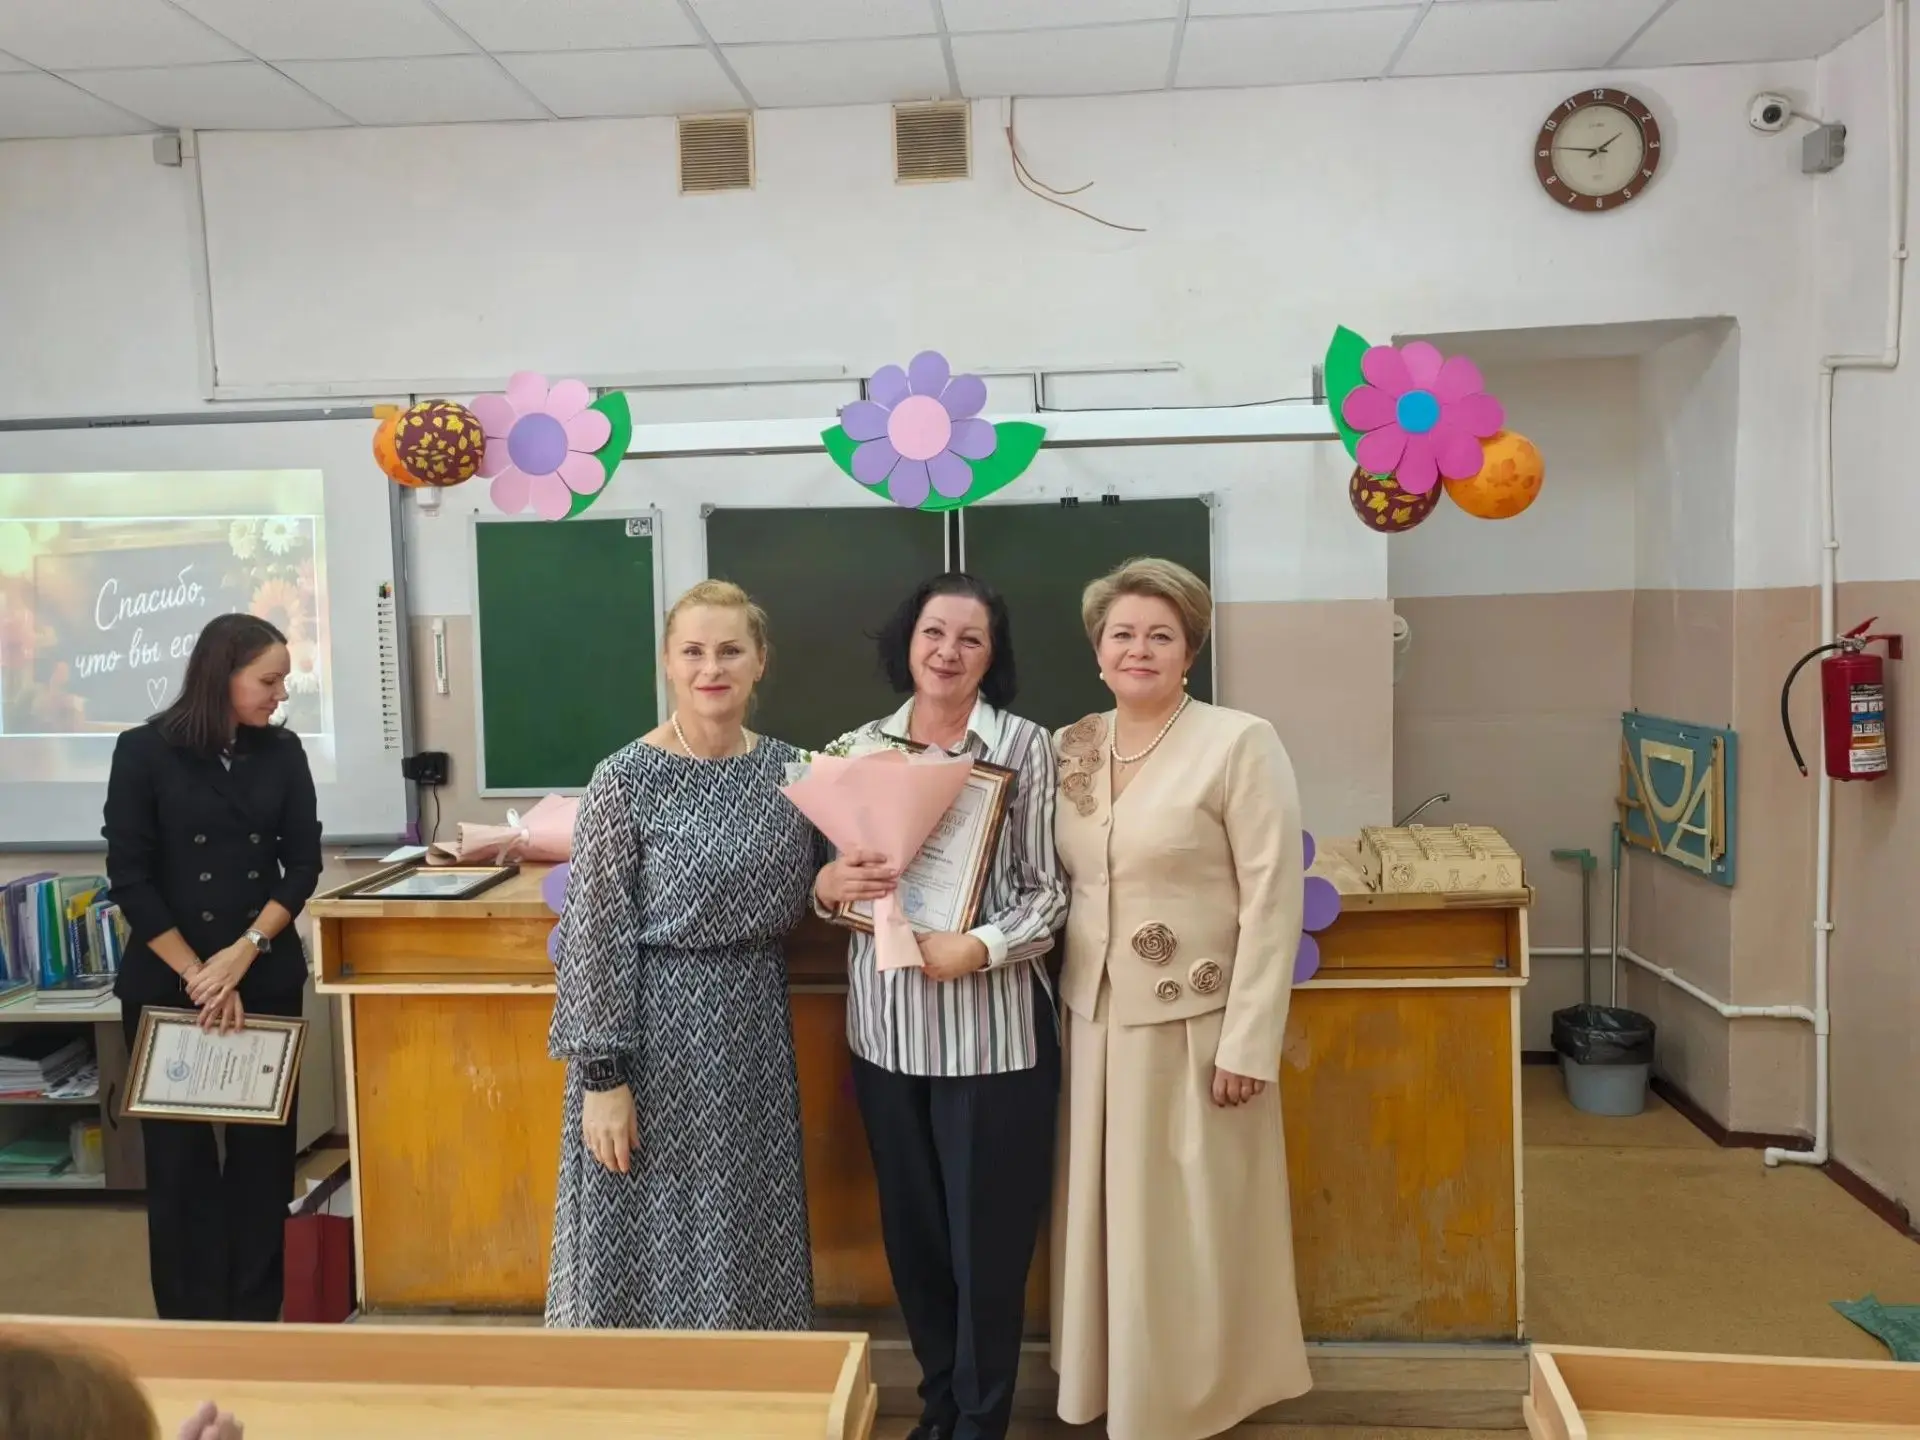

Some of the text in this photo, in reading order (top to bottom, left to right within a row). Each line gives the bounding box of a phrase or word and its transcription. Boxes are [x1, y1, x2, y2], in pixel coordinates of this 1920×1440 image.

[1592, 89, 1604, 100] 12
[1623, 95, 1630, 104] 1
[1564, 98, 1577, 111] 11
[1641, 113, 1652, 123] 2
[1544, 119, 1557, 132] 10
[1649, 141, 1660, 149] 3
[1641, 168, 1652, 178] 4
[1546, 175, 1557, 185] 8
[1568, 193, 1577, 203] 7
[1623, 188, 1632, 198] 5
[94, 563, 206, 631] Спасибо,
[75, 653, 121, 679] что
[129, 627, 162, 668] вы
